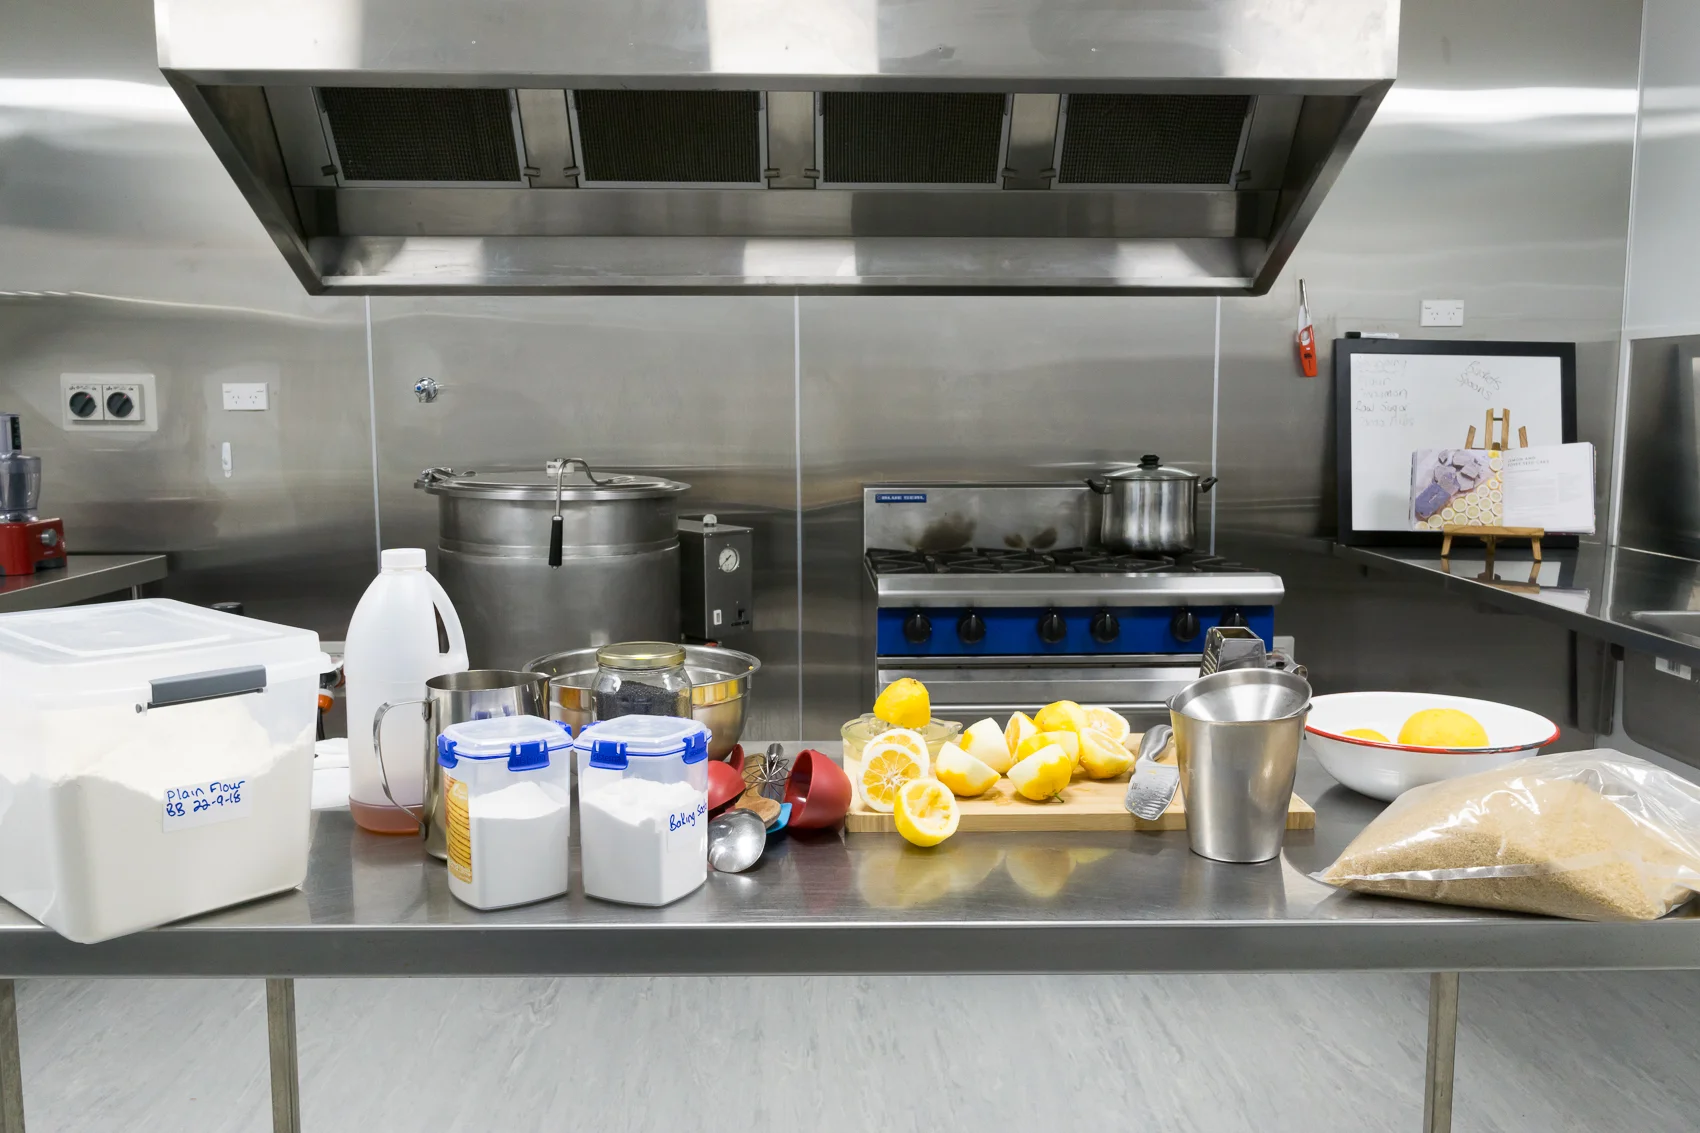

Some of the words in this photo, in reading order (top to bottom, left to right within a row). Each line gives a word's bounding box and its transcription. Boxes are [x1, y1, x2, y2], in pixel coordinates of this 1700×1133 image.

[1455, 372, 1493, 401] Spoons
[167, 788, 204, 802] Plain
[210, 780, 246, 793] Flour
[166, 802, 186, 817] BB
[193, 790, 241, 812] 22-9-18
[669, 811, 696, 832] Baking
